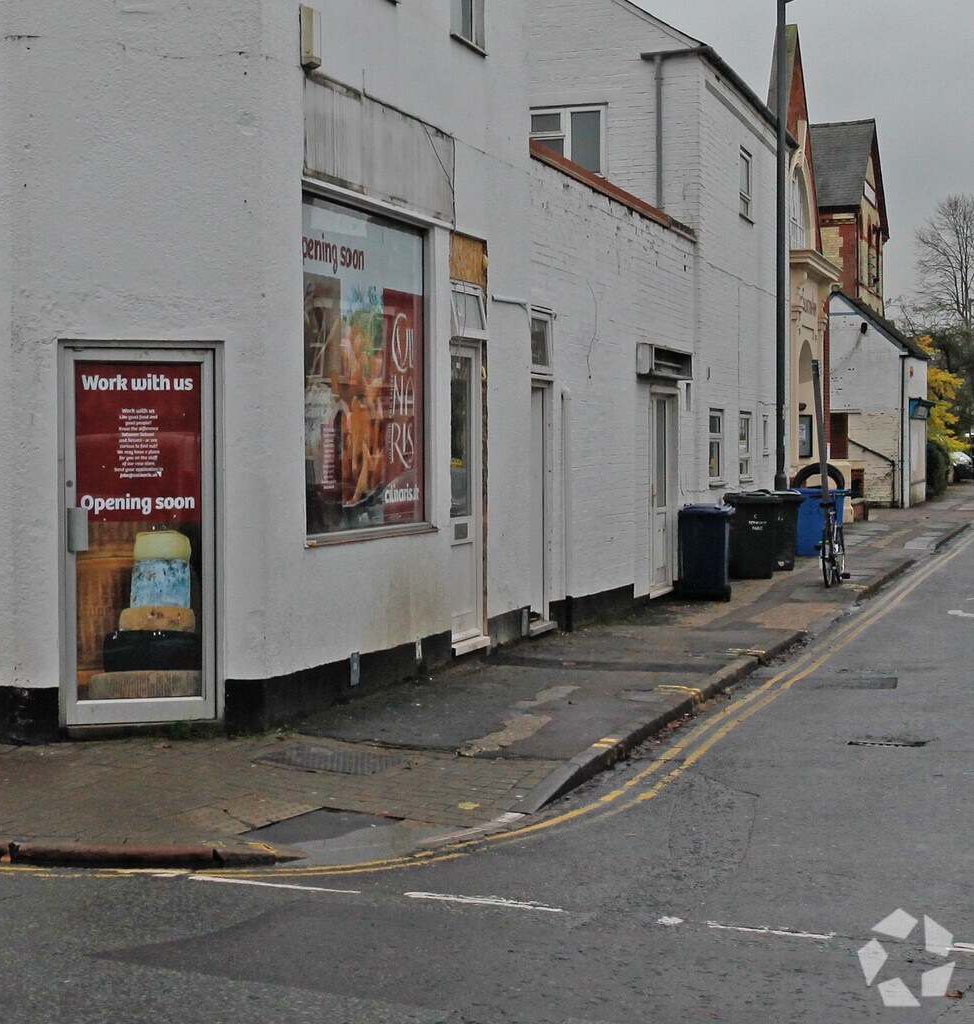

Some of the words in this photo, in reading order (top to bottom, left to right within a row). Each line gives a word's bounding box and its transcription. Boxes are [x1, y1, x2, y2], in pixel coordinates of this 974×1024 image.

[302, 232, 338, 274] pening
[340, 245, 365, 271] soon
[81, 373, 128, 391] Work
[131, 373, 170, 391] with
[173, 377, 194, 391] us
[80, 493, 152, 515] Opening
[155, 496, 195, 510] soon
